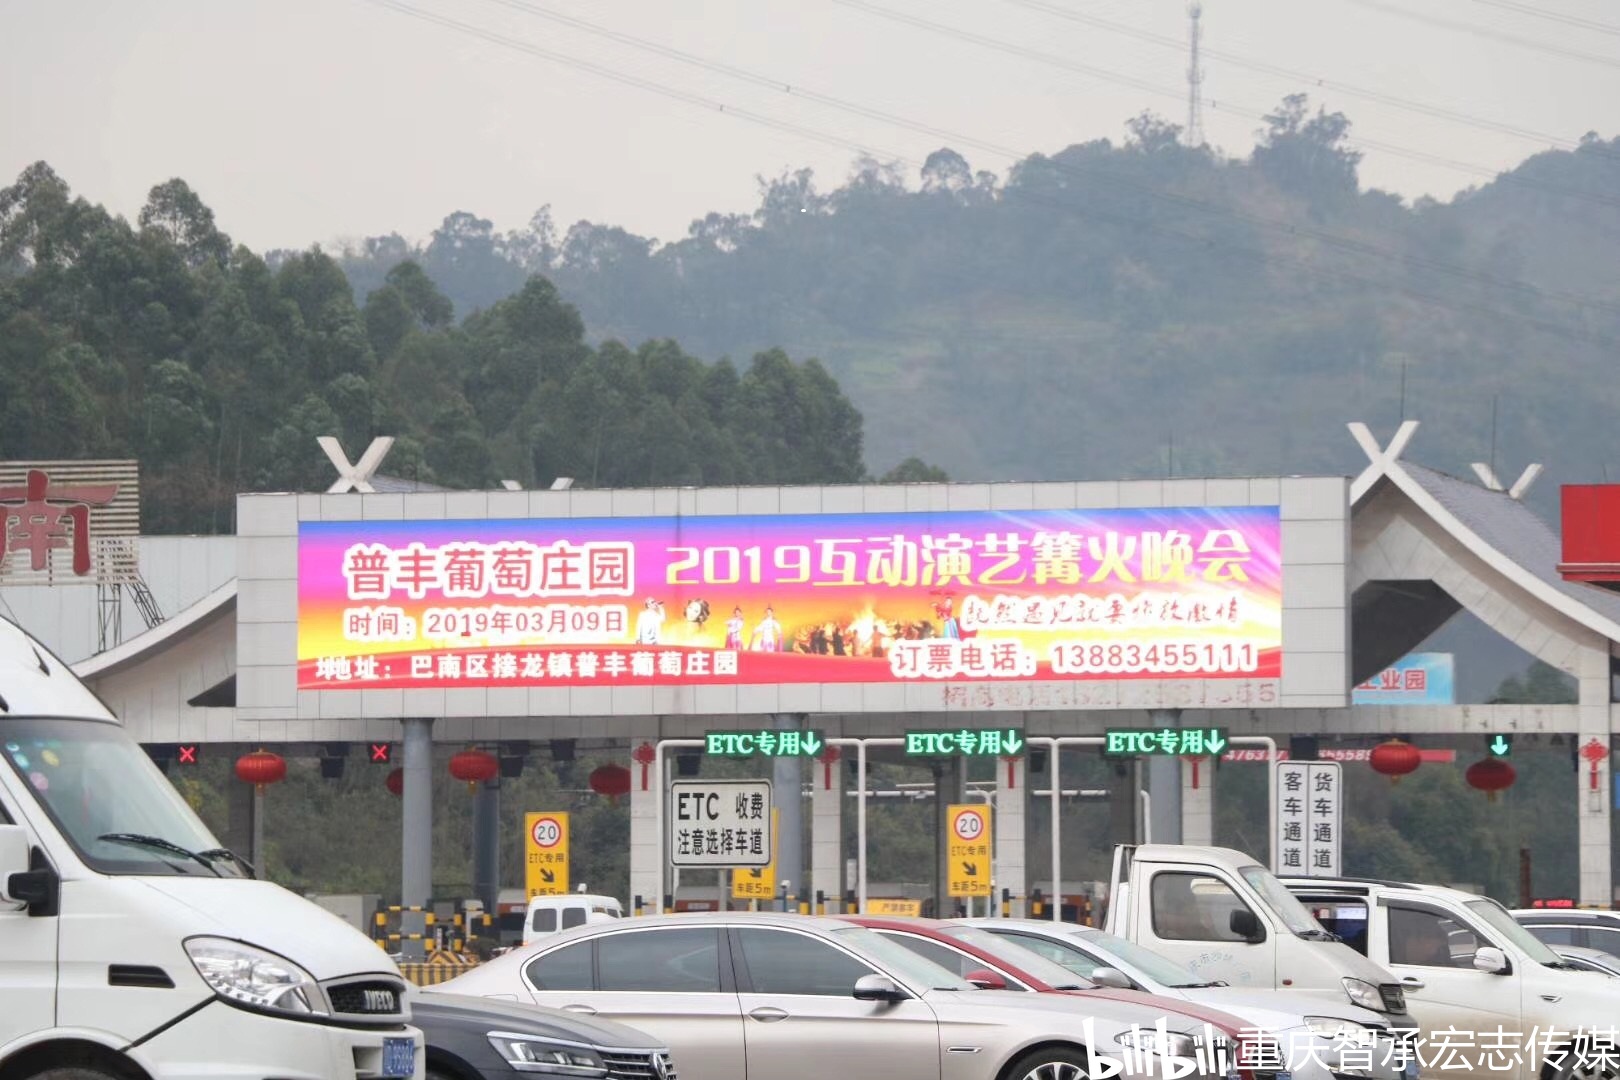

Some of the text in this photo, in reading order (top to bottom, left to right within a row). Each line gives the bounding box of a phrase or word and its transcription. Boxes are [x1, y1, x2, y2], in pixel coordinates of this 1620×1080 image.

[665, 529, 1251, 587] 2019互动演艺篝火晚会
[346, 545, 631, 596] 普丰葡萄庄园
[706, 731, 799, 755] ETC专用
[906, 730, 1000, 754] ETC专用
[1106, 729, 1202, 753] ETC专用
[677, 792, 764, 820] ETC 收费
[960, 818, 979, 832] 20
[1283, 771, 1302, 867] 客车通道
[1313, 771, 1333, 868] 货车通道
[537, 825, 556, 840] 20
[677, 828, 764, 856] 注意选择车道
[529, 852, 565, 864] ETC专用
[951, 845, 987, 857] ETC专用
